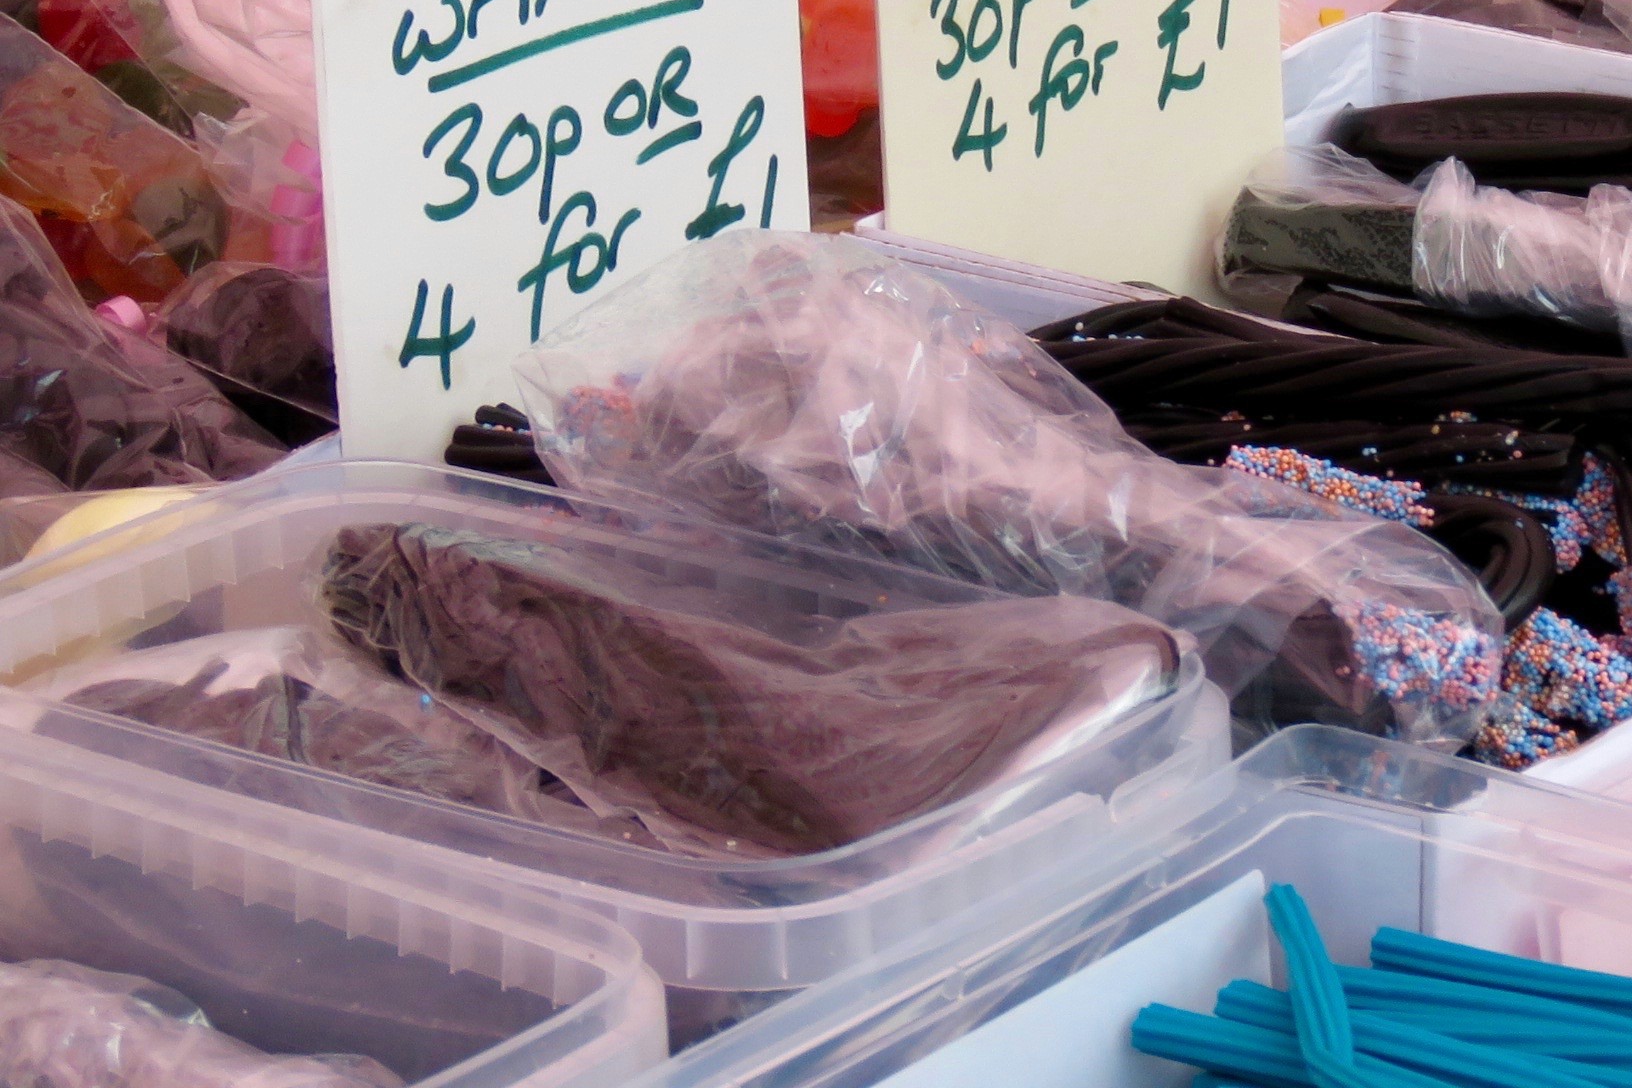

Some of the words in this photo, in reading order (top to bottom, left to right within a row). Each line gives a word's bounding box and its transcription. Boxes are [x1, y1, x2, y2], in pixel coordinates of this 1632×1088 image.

[423, 103, 582, 224] 30p
[604, 46, 699, 136] OR
[952, 78, 1007, 172] 4
[1029, 24, 1118, 158] for
[399, 278, 475, 391] 4
[518, 191, 642, 344] for
[685, 95, 779, 240] £1
